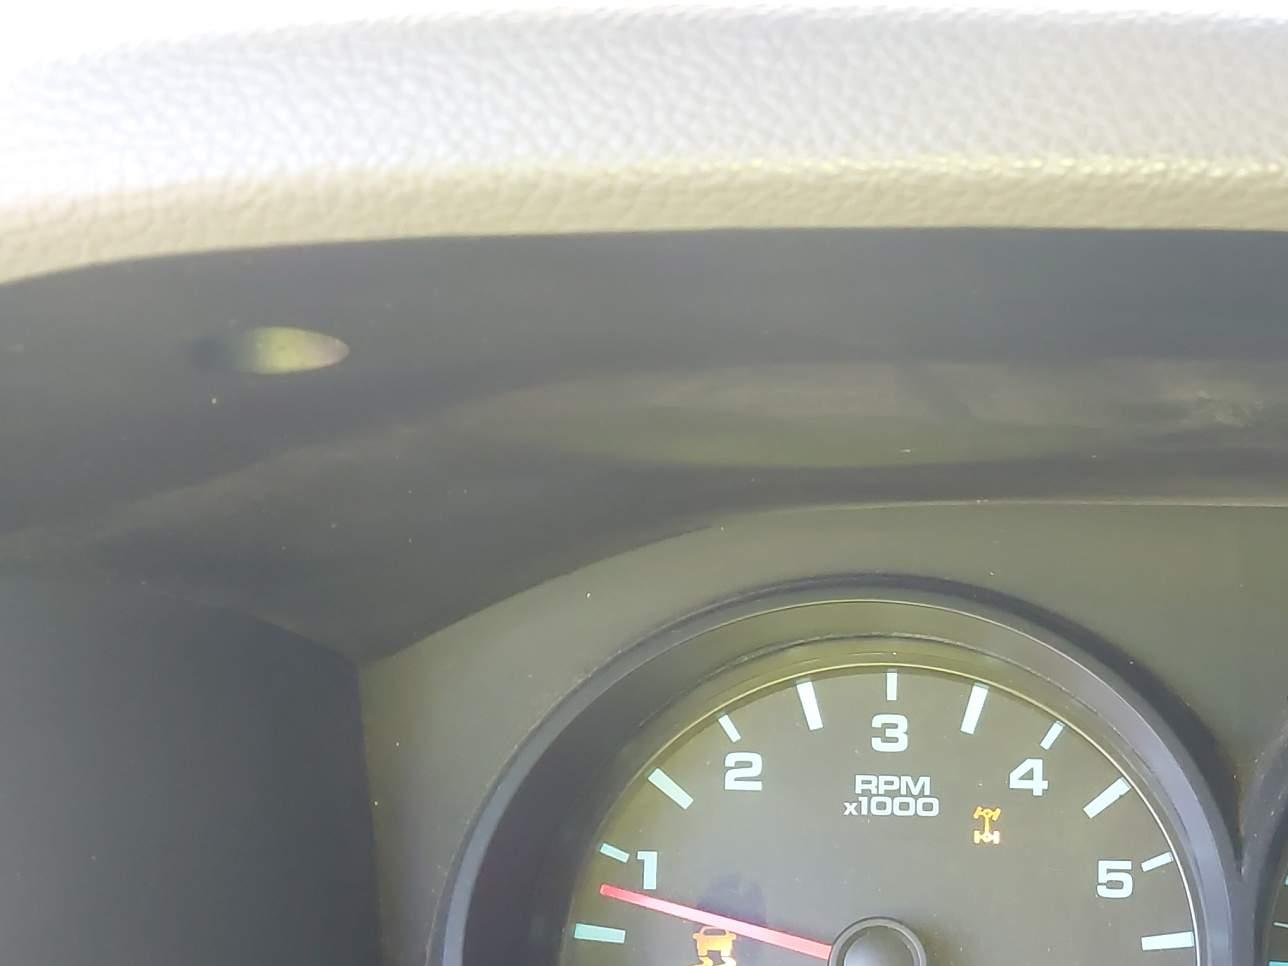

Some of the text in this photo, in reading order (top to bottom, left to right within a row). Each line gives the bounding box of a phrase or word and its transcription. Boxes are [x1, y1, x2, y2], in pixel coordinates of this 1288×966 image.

[871, 714, 909, 752] 3
[724, 752, 763, 791] 2
[854, 774, 931, 794] RPM
[1009, 758, 1048, 796] 4
[843, 797, 940, 816] x1000
[636, 850, 658, 889] 1
[1096, 859, 1133, 898] 5
